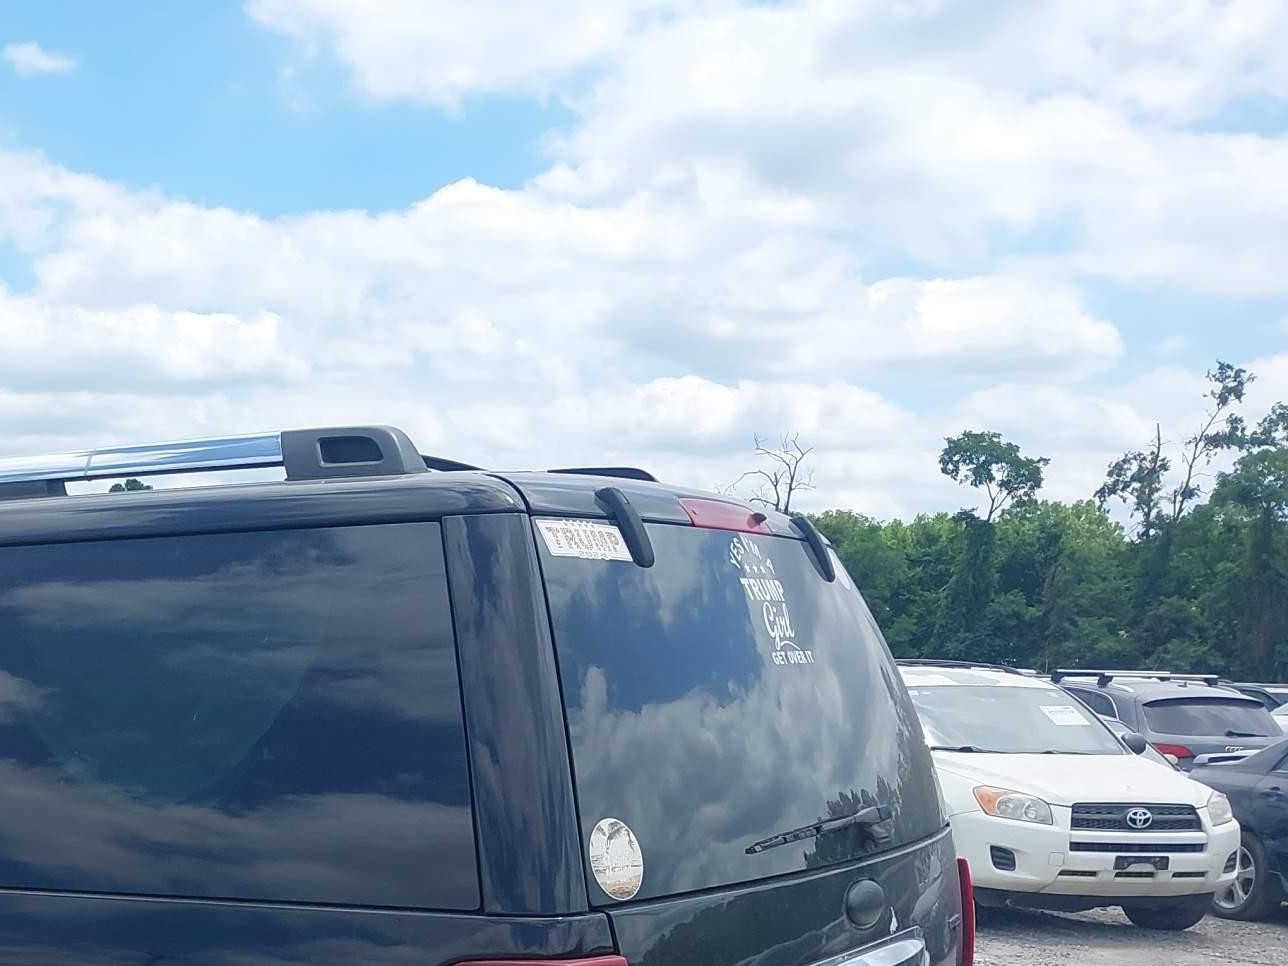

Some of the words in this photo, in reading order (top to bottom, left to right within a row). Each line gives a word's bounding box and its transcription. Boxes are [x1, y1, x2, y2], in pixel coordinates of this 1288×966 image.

[545, 526, 620, 553] TRUMP
[729, 537, 745, 569] YES
[739, 577, 785, 602] TRUMP
[763, 601, 796, 651] Girl
[772, 651, 789, 665] GET
[787, 650, 808, 664] OVER
[804, 650, 815, 664] IT
